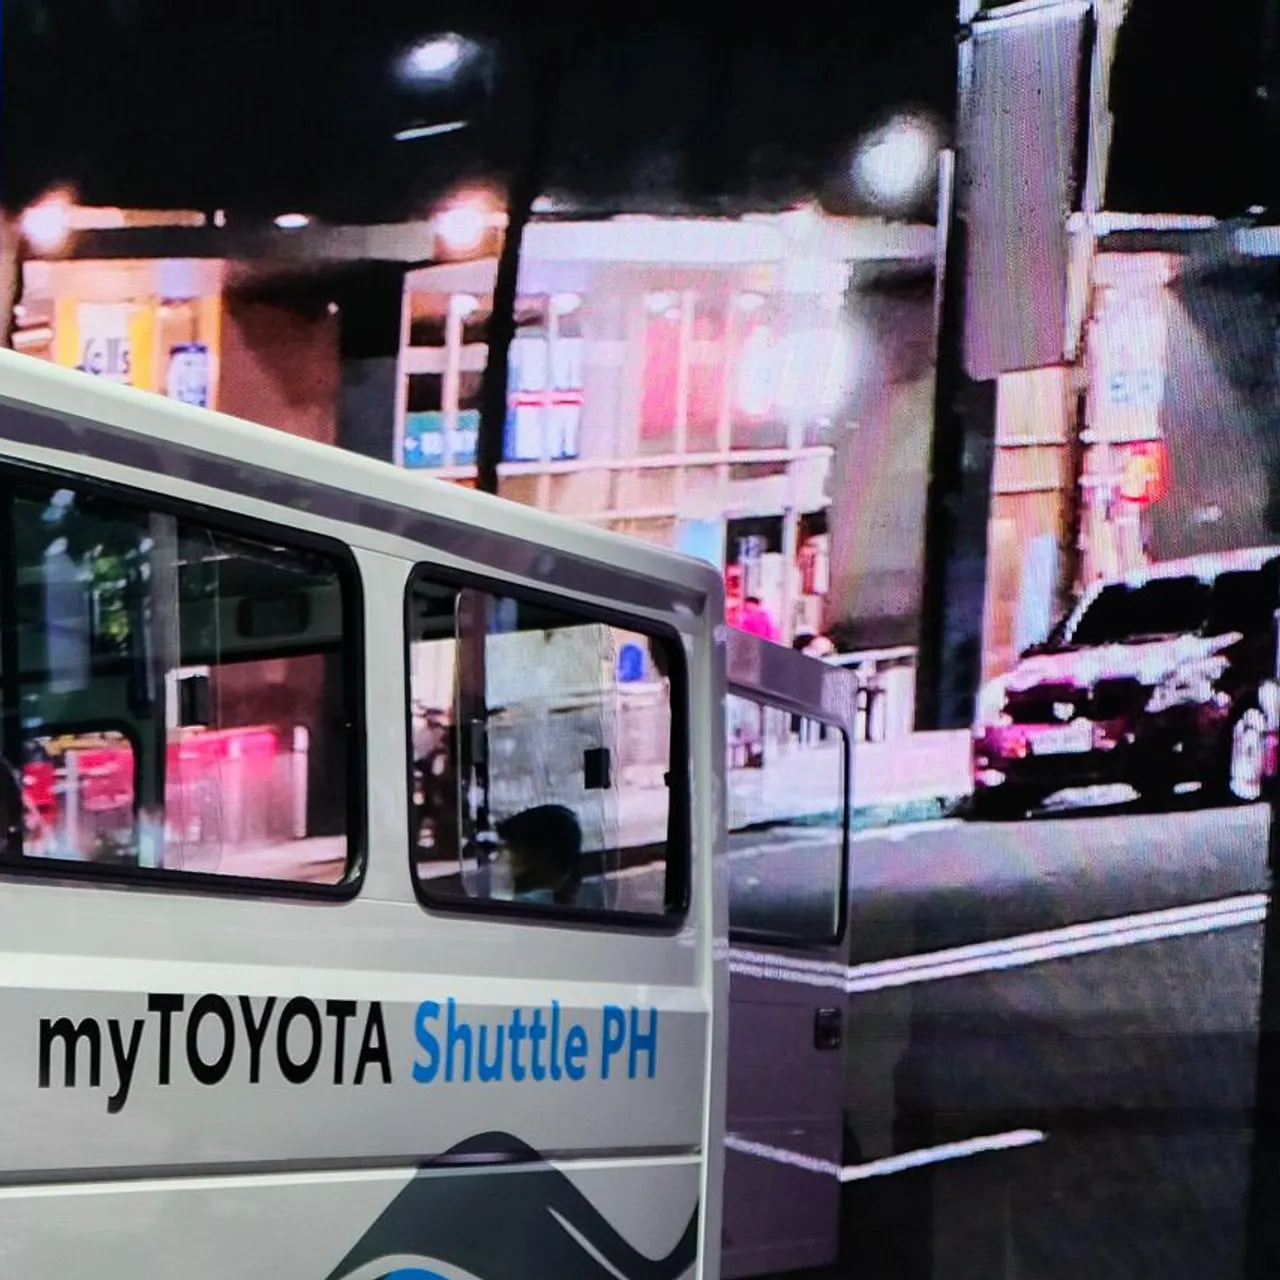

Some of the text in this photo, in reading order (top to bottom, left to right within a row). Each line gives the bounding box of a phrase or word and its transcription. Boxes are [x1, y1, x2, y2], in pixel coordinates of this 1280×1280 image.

[38, 993, 659, 1115] myTOYOTA Shuttle PH
